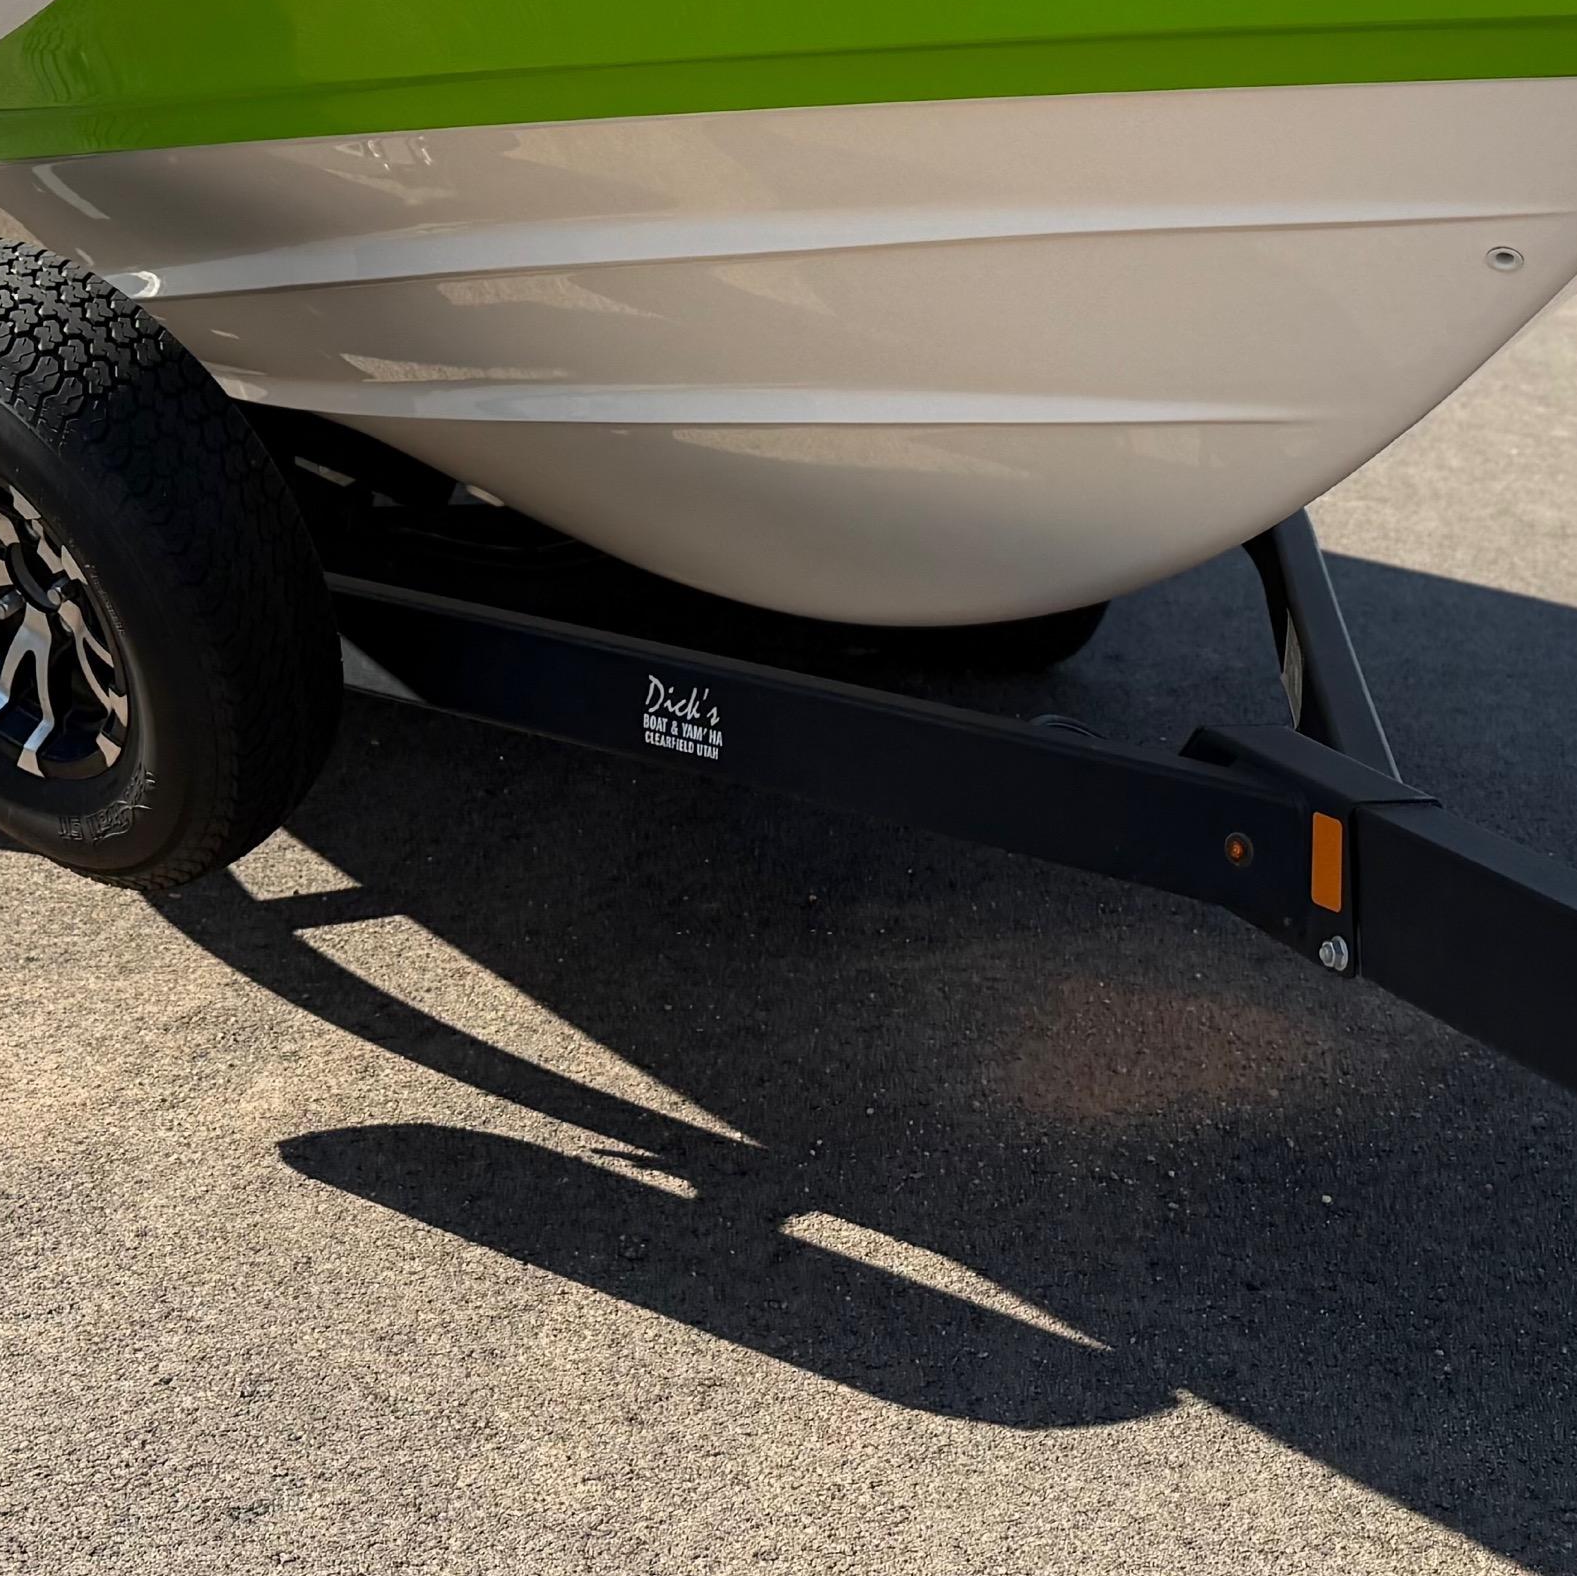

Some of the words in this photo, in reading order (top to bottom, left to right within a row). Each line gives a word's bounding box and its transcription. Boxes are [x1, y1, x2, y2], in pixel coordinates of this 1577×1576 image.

[645, 674, 720, 726] Dick's
[643, 713, 668, 732] BOAT
[670, 720, 679, 736] &
[644, 730, 694, 754] CLEARFIELD
[696, 743, 719, 760] UTAH
